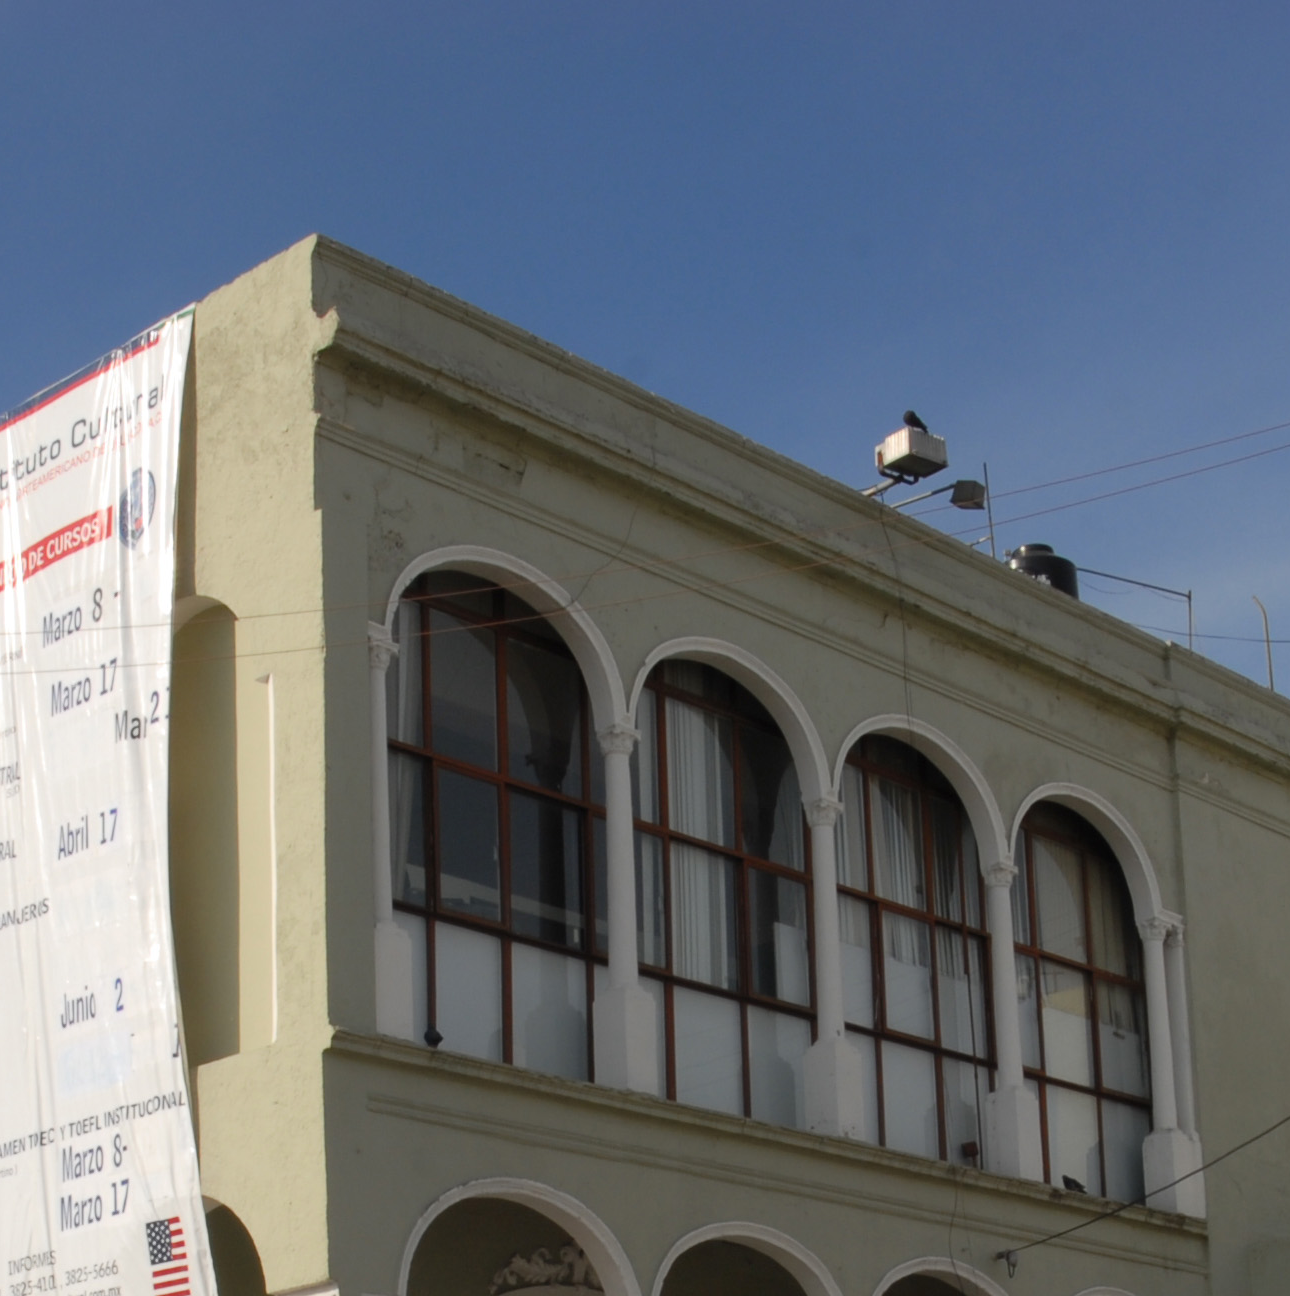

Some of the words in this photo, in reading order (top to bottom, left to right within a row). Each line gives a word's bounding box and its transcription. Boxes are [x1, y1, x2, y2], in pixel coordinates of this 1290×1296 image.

[12, 451, 90, 500] RTEAMERICANO
[29, 548, 45, 570] DE
[47, 518, 99, 559] CURSOS
[42, 605, 82, 648] Marzo
[92, 588, 103, 622] 8
[50, 675, 91, 717] Marzo
[99, 658, 117, 696] 17
[58, 816, 89, 860] Abril
[99, 808, 118, 846] 17
[61, 985, 96, 1029] Junio
[114, 978, 123, 1012] 2
[28, 1128, 54, 1149] TOEC
[59, 1127, 67, 1141] Y
[68, 1117, 102, 1139] TOEFL
[104, 1091, 186, 1126] INSTITUCONAL
[62, 1145, 104, 1183] Marzo
[60, 1191, 103, 1232] Marzo
[111, 1179, 130, 1217] 17
[8, 1251, 57, 1276] INFORMES
